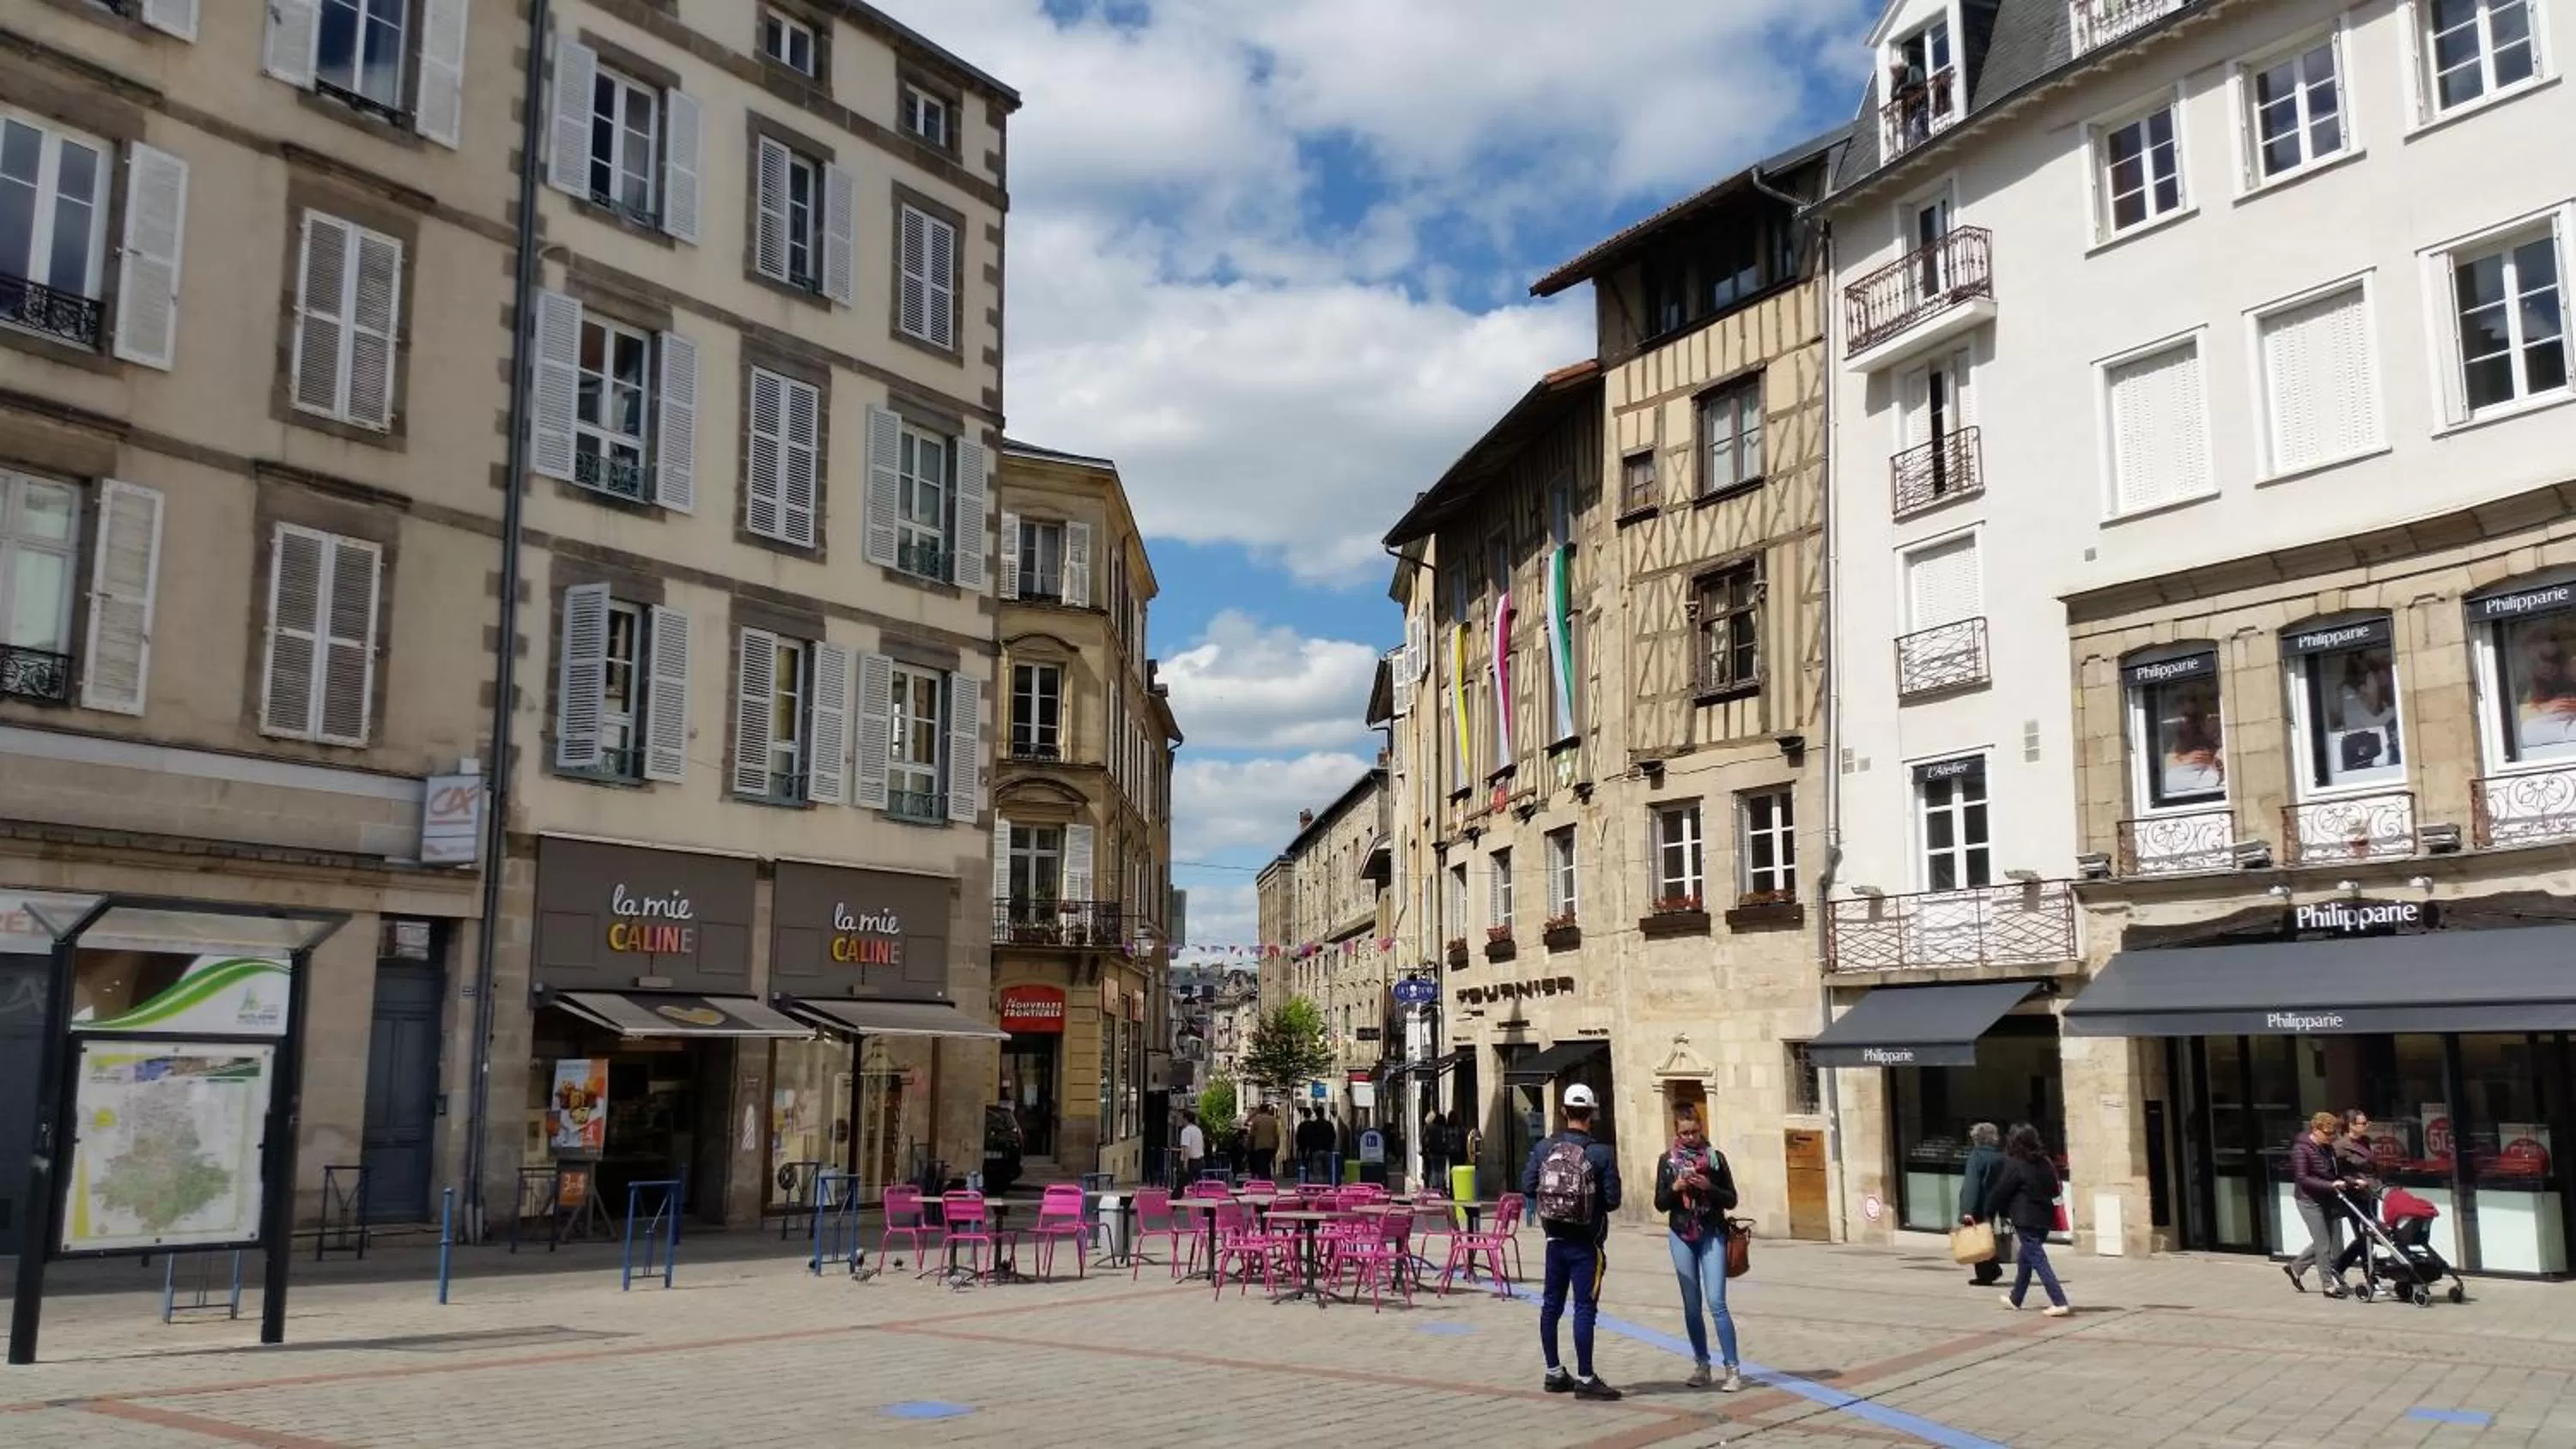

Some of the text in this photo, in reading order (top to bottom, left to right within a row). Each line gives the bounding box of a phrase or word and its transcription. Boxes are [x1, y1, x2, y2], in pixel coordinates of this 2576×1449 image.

[2484, 585, 2568, 615] Philipparie
[2298, 623, 2370, 649] Philipparie
[2136, 655, 2199, 681] Philipparie
[611, 883, 693, 919] la mie
[835, 902, 901, 935] la mie
[2296, 900, 2418, 931] Philipparie
[2267, 1012, 2343, 1030] Philipparie
[1864, 1048, 1914, 1064] Philipparie
